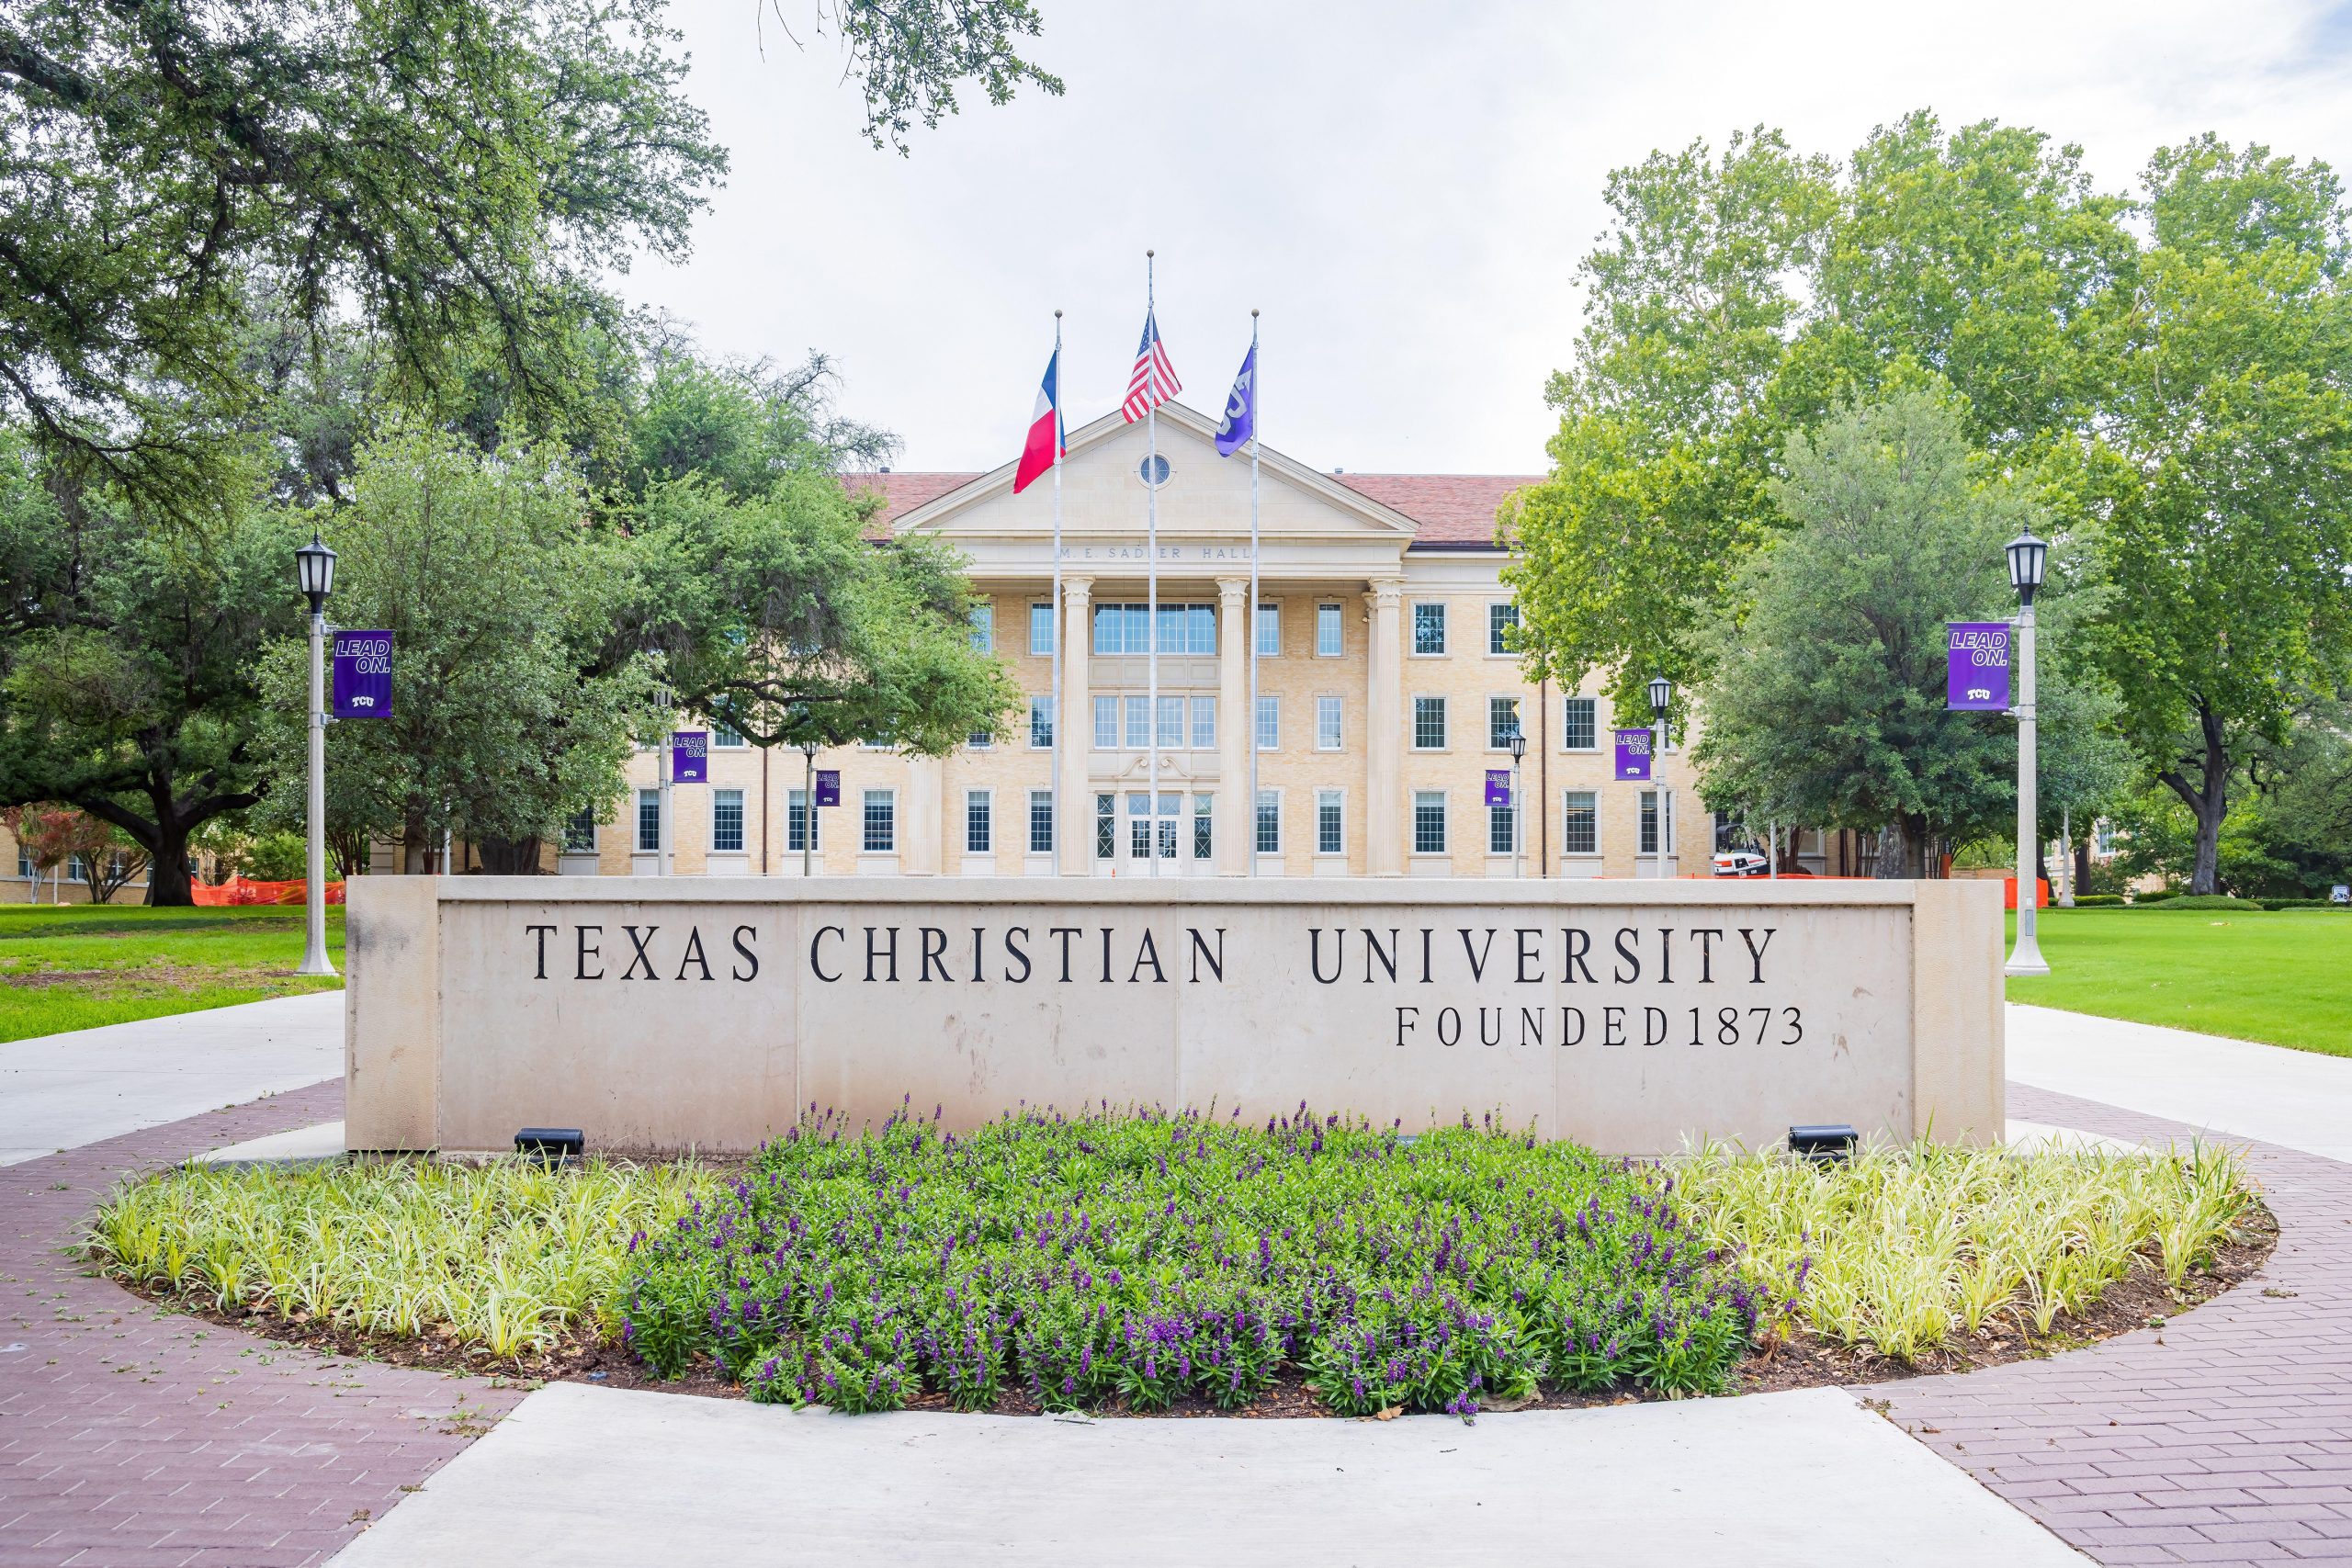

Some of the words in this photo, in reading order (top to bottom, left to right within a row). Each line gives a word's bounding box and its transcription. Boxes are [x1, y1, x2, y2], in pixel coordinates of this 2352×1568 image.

[1108, 547, 1181, 558] SADER
[1203, 547, 1250, 558] HALL
[1951, 632, 2007, 649] LEAD
[335, 639, 390, 657] LEAD
[1972, 649, 2007, 666] ON.
[356, 657, 390, 674] ON.
[1967, 689, 1991, 700] TCU
[352, 696, 375, 707] TCU
[673, 738, 707, 748] LEAD
[1616, 735, 1649, 745] LEAD
[686, 747, 707, 758] ON.
[1628, 745, 1650, 755] ON.
[526, 925, 759, 983] TEXAS
[810, 926, 1227, 984] CHRISTIAN
[1307, 928, 1777, 984] UNIVERSITY
[1395, 1007, 1668, 1046] FOUNDED
[1688, 1007, 1803, 1046] 1873
